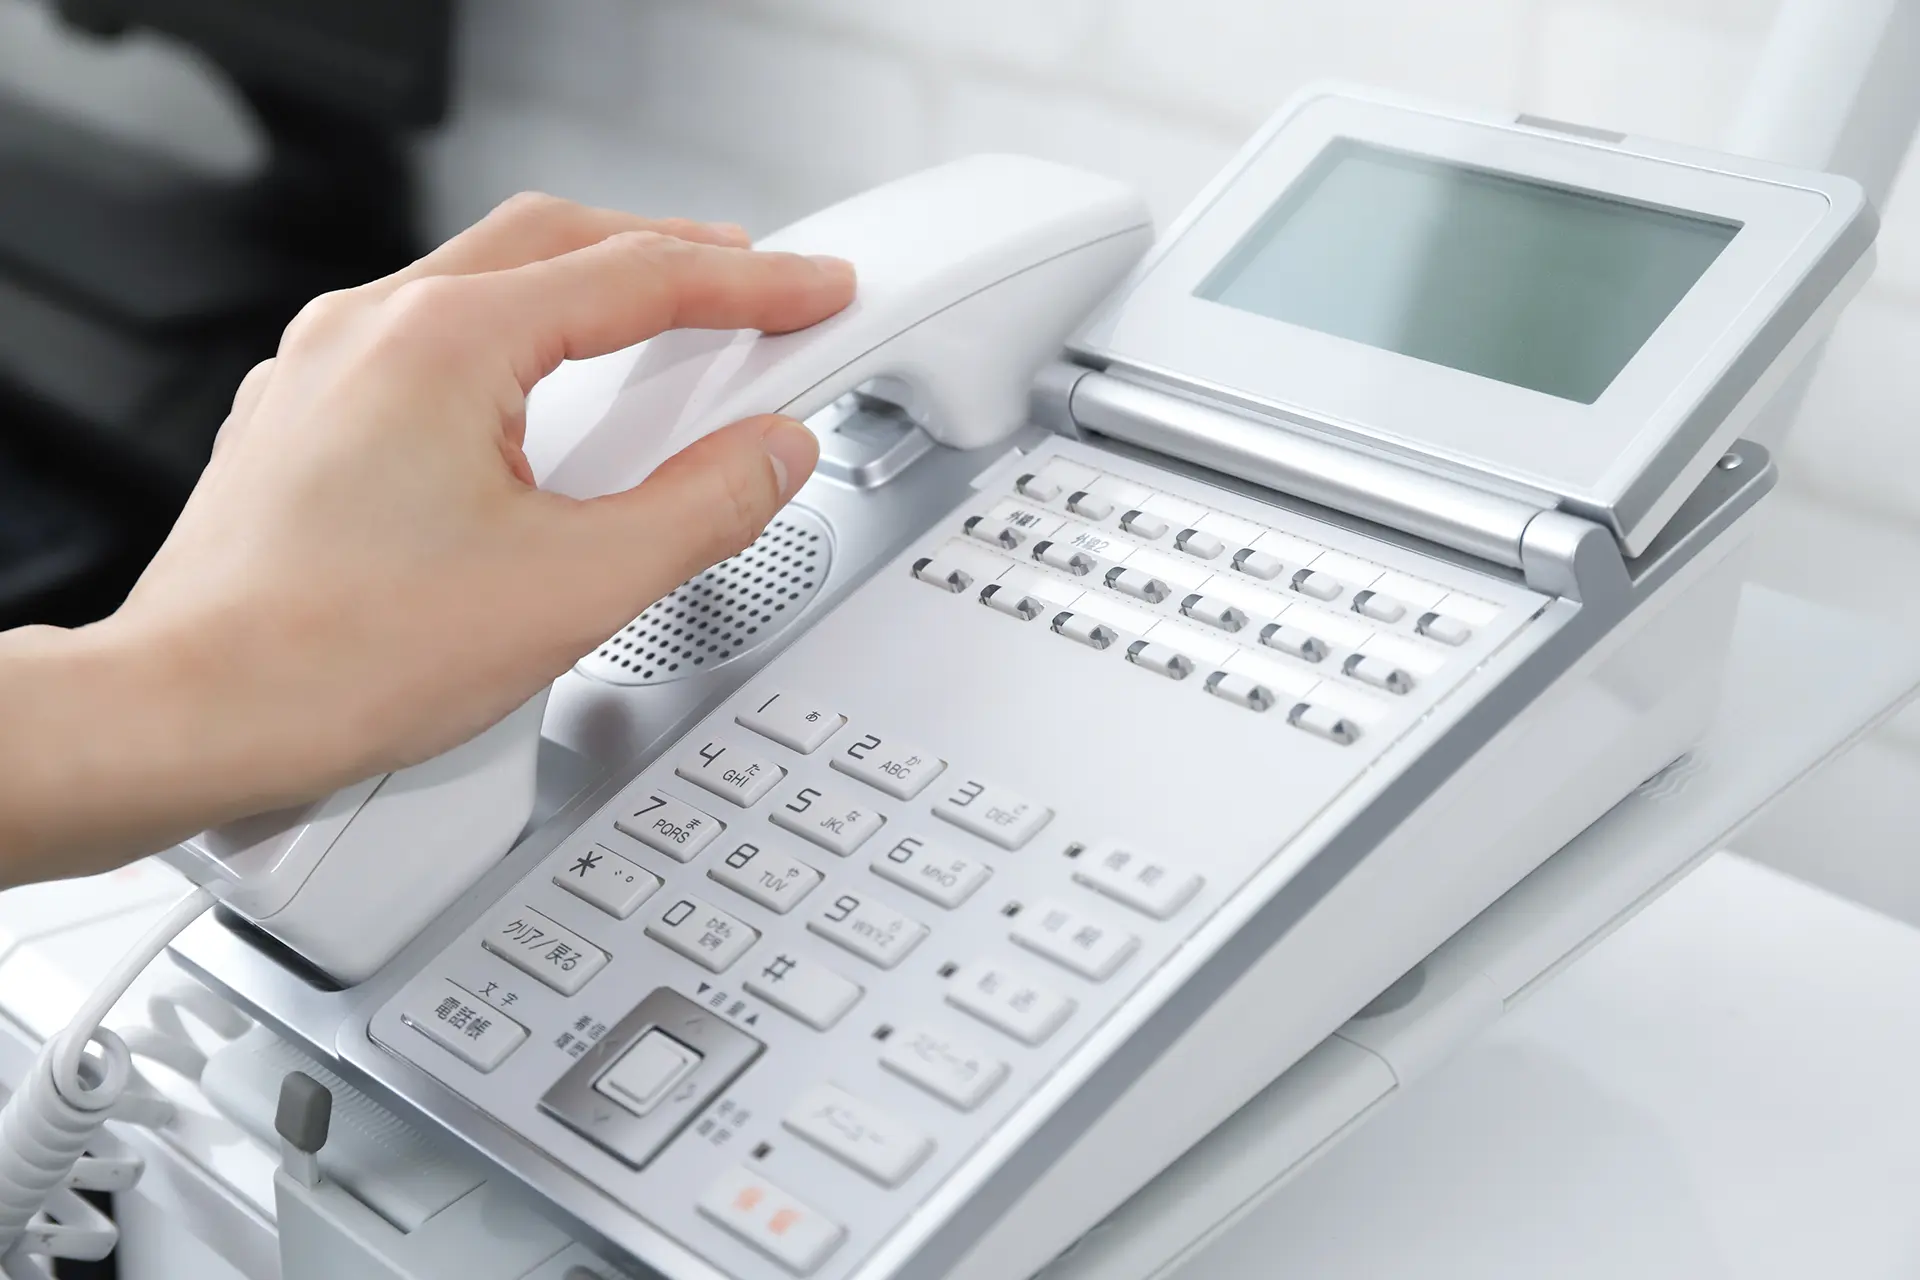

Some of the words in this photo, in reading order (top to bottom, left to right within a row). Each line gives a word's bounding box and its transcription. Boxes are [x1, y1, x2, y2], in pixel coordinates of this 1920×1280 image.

[757, 693, 781, 713] 1
[805, 710, 821, 723] あ
[699, 742, 726, 768] 4
[847, 734, 881, 760] 2
[722, 768, 750, 788] GHI
[745, 763, 760, 777] た
[879, 760, 911, 781] ABC
[633, 795, 667, 817] 7
[785, 788, 822, 813] 5
[948, 780, 985, 807] 3
[652, 818, 690, 844] PQRS
[685, 818, 702, 831] ま
[820, 815, 845, 835] JKL
[724, 843, 760, 869] 8
[887, 837, 924, 864] 6
[759, 870, 788, 892] TUV
[662, 900, 696, 927] 0
[824, 895, 860, 922] 9
[434, 996, 492, 1041] 電話帳
